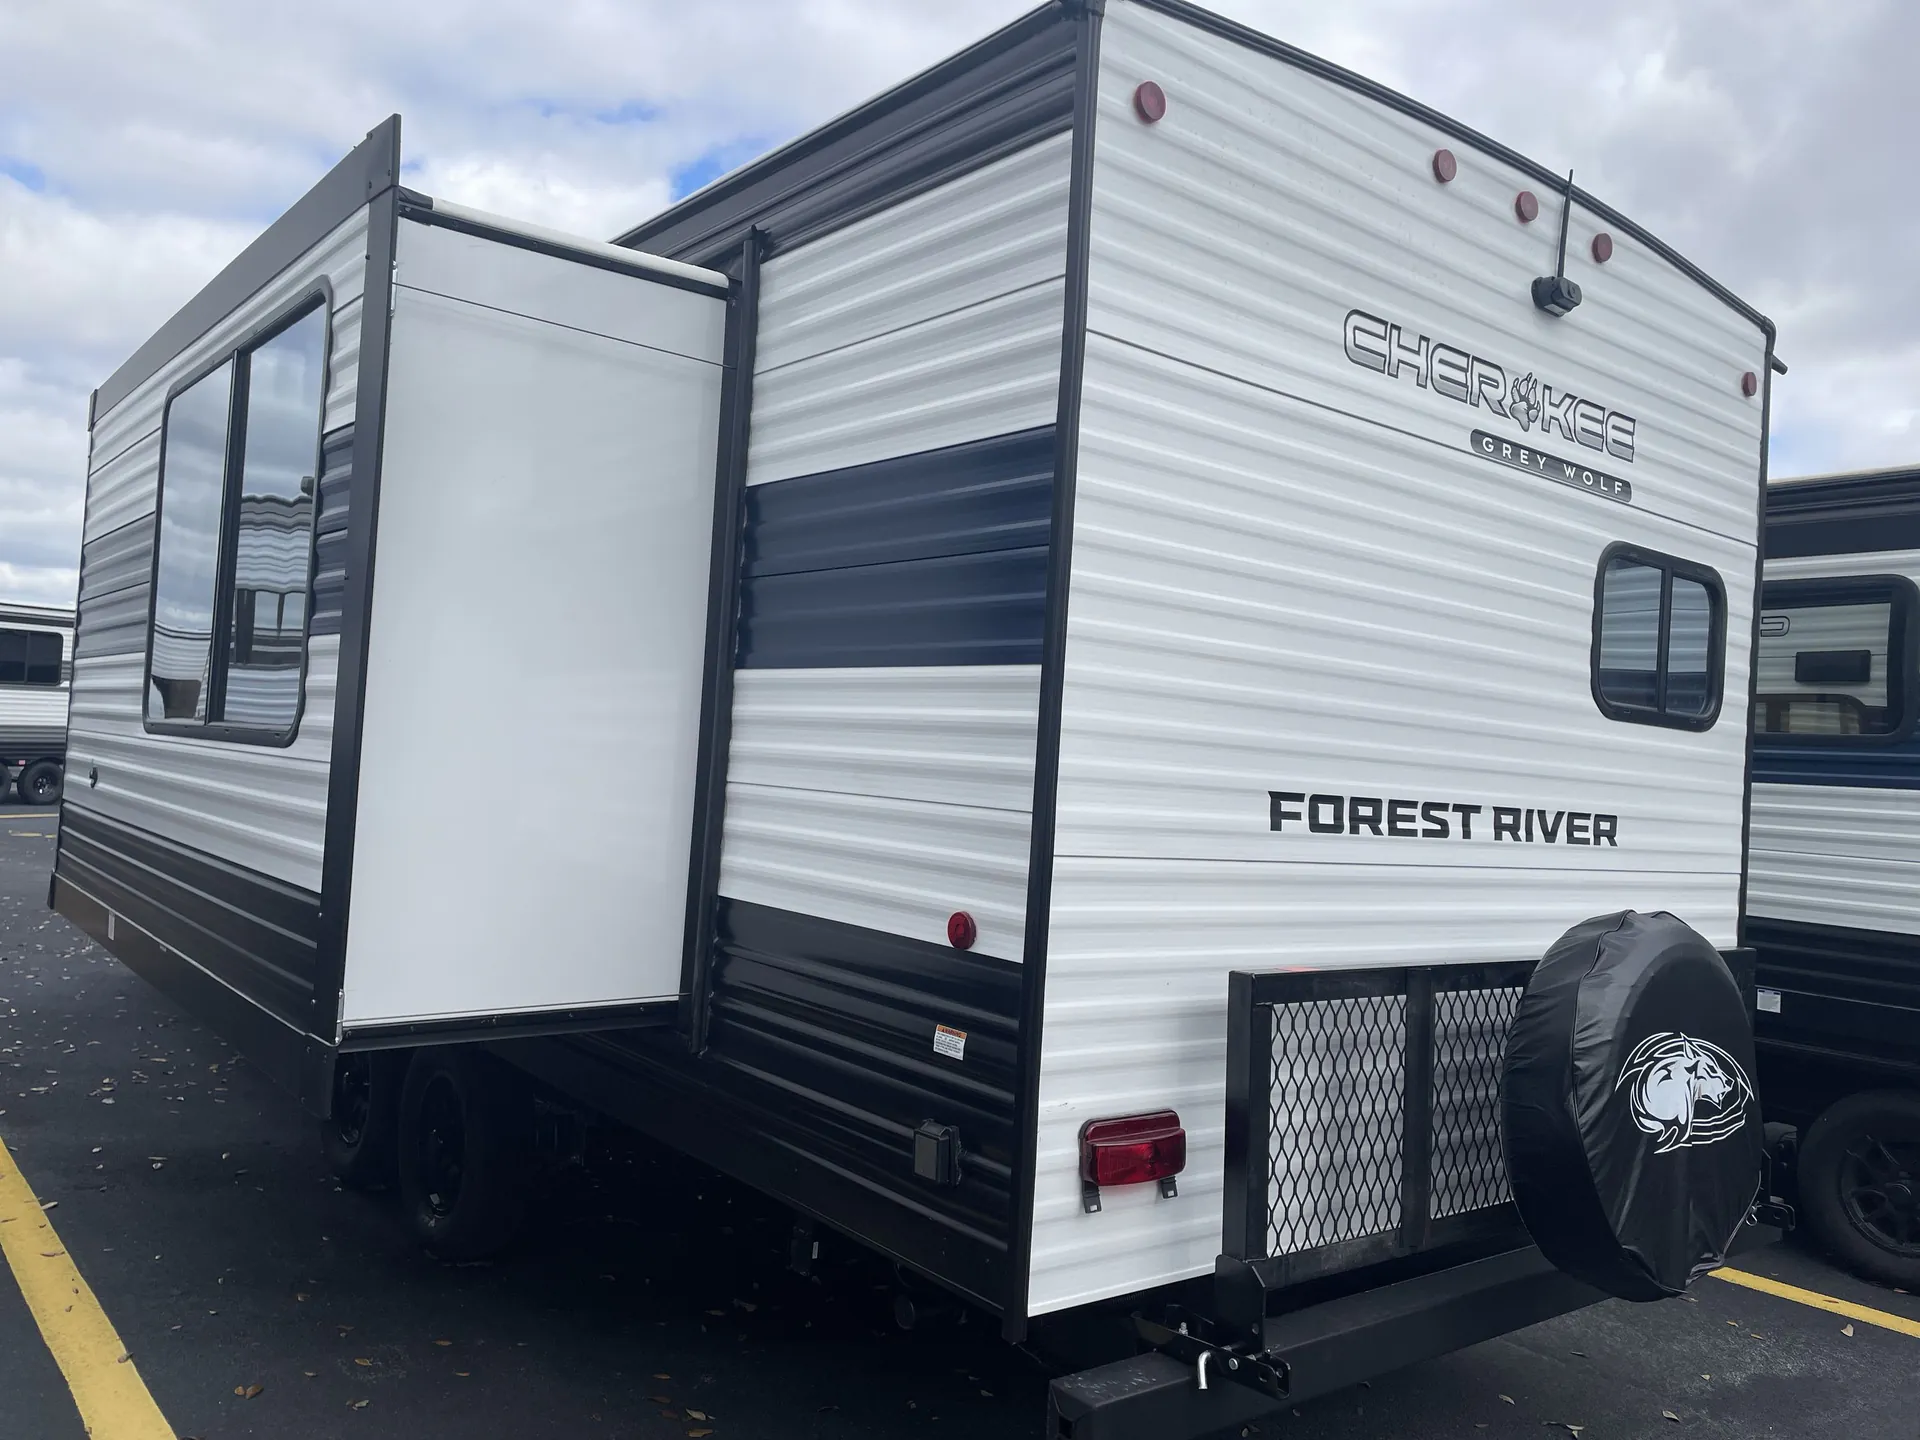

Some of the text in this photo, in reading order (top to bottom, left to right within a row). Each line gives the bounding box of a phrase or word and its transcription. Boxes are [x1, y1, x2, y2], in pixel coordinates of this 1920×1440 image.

[1482, 437, 1623, 495] GREY WOLF
[1267, 790, 1619, 847] FOREST RIVER
